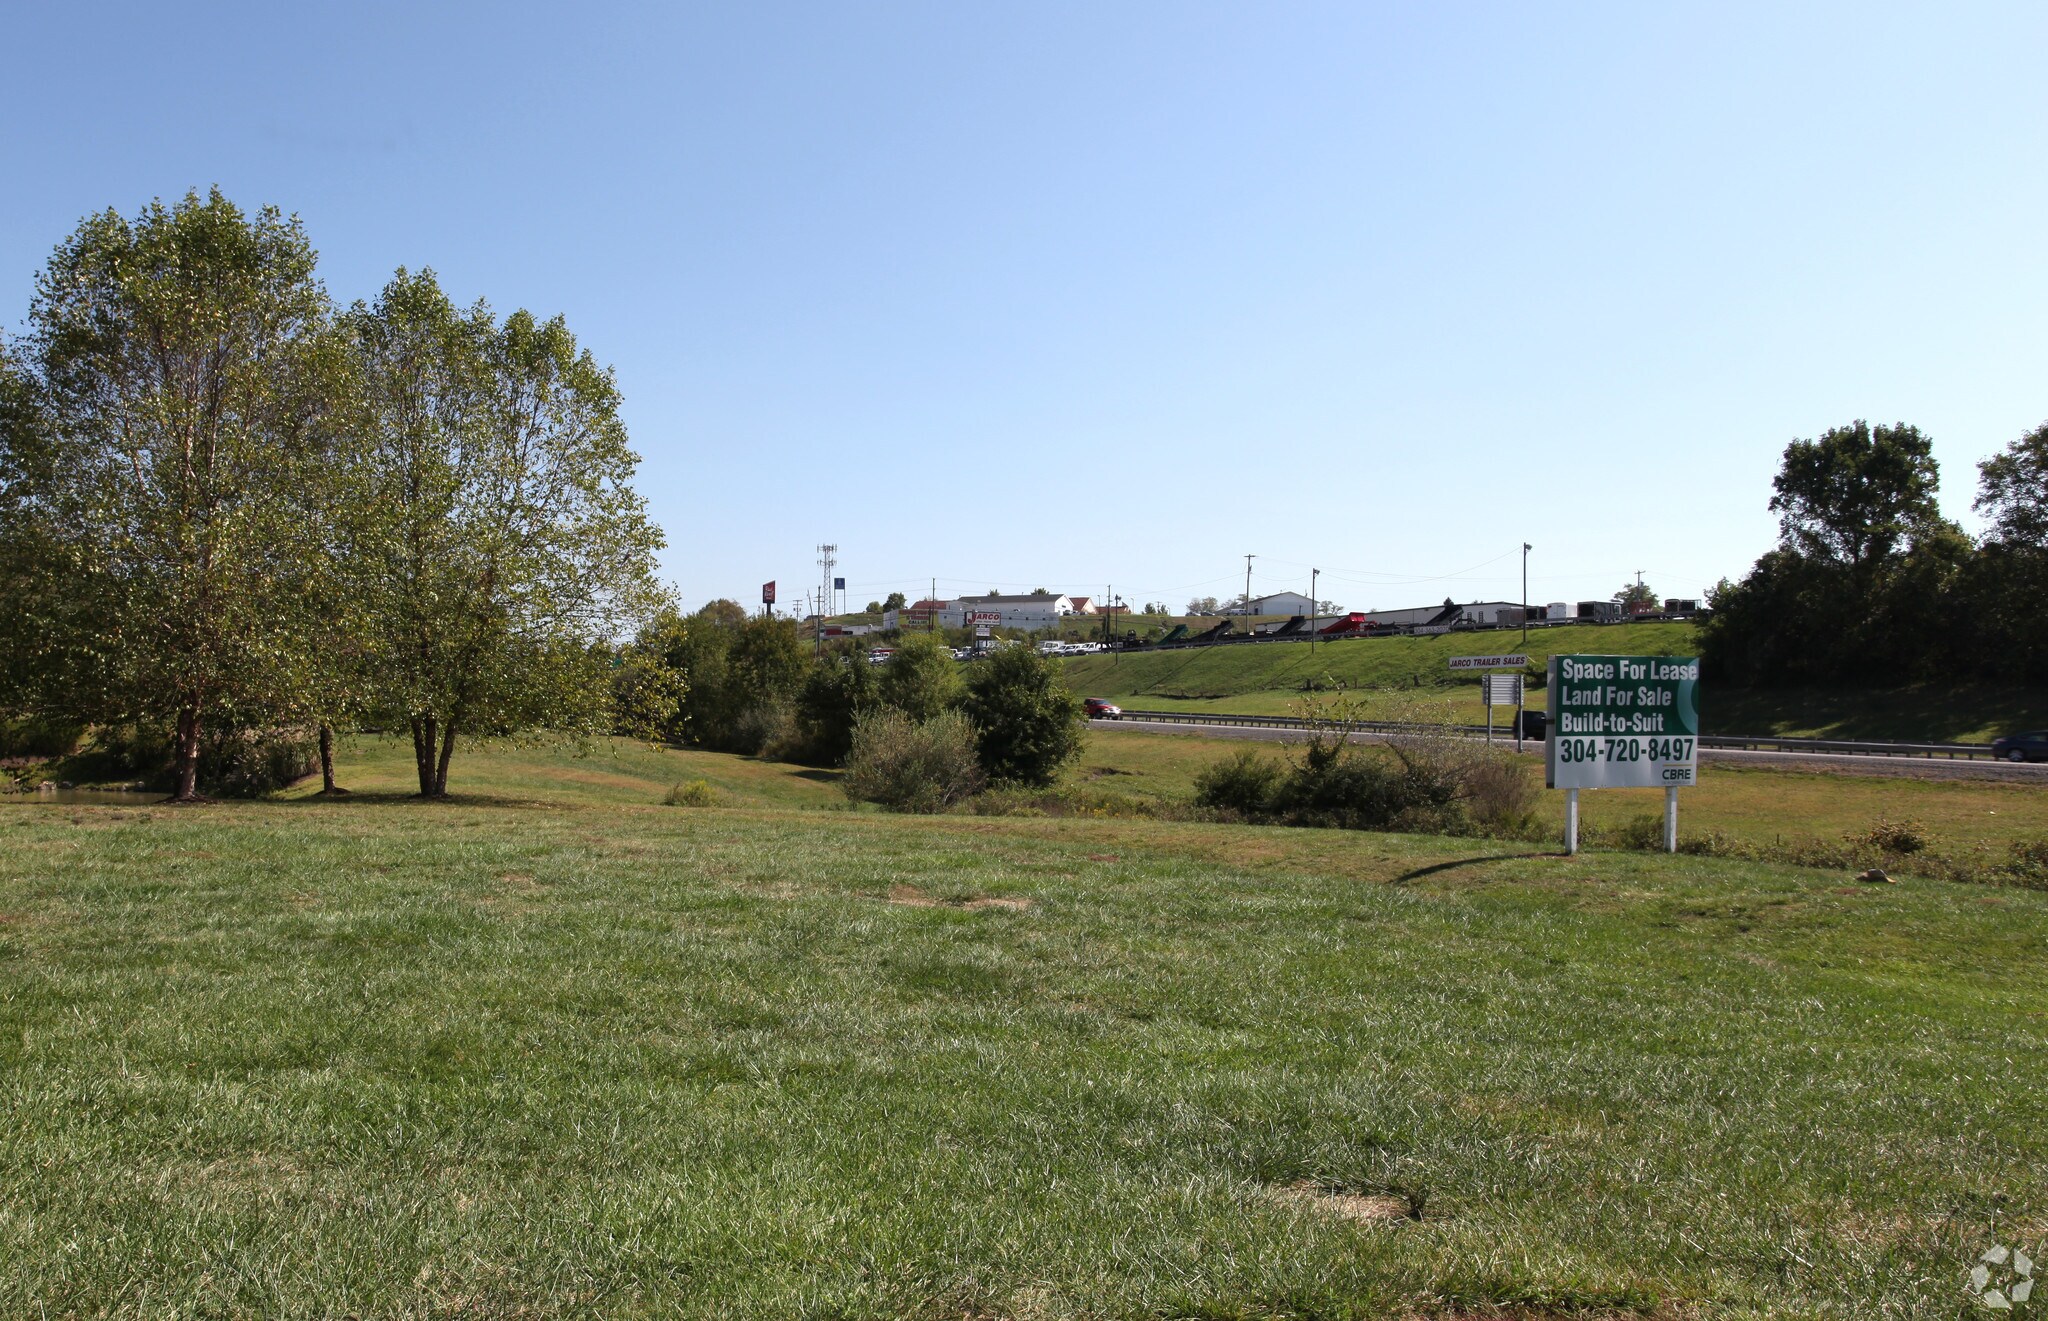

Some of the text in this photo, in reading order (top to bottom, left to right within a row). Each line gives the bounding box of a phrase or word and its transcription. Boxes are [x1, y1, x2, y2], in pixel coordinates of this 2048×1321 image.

[968, 612, 1000, 624] JARCO
[1450, 657, 1525, 667] JARCO TRAILER SALES
[1562, 658, 1698, 683] Space For Lease
[1562, 686, 1672, 706] Land For Sale
[1561, 712, 1664, 732] Build-to-Suit
[1560, 738, 1694, 763] 304-720-8497
[1662, 769, 1692, 780] CBRE
